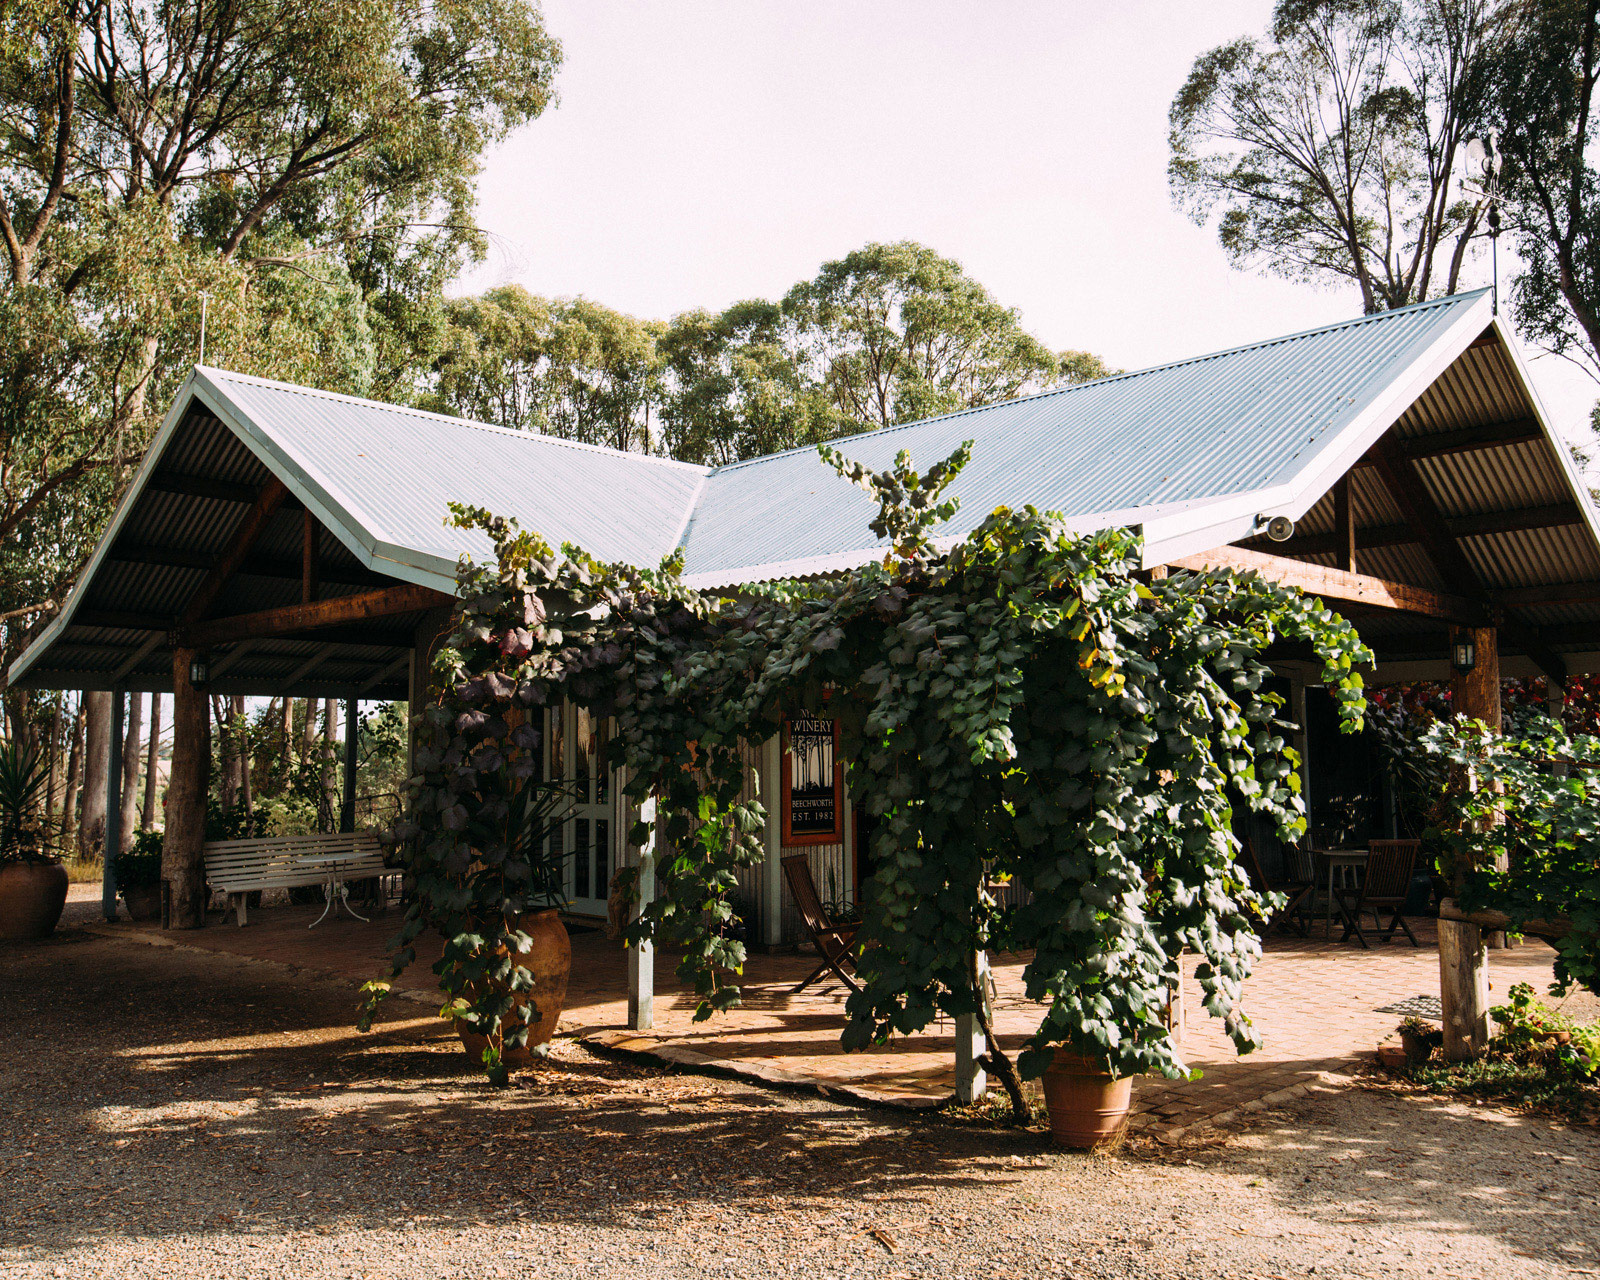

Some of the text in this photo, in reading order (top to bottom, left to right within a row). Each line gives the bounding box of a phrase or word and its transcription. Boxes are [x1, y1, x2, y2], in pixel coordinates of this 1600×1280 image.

[791, 720, 833, 732] WINERY
[792, 799, 833, 808] BEECHWORTH
[792, 811, 833, 821] EST. 1982
